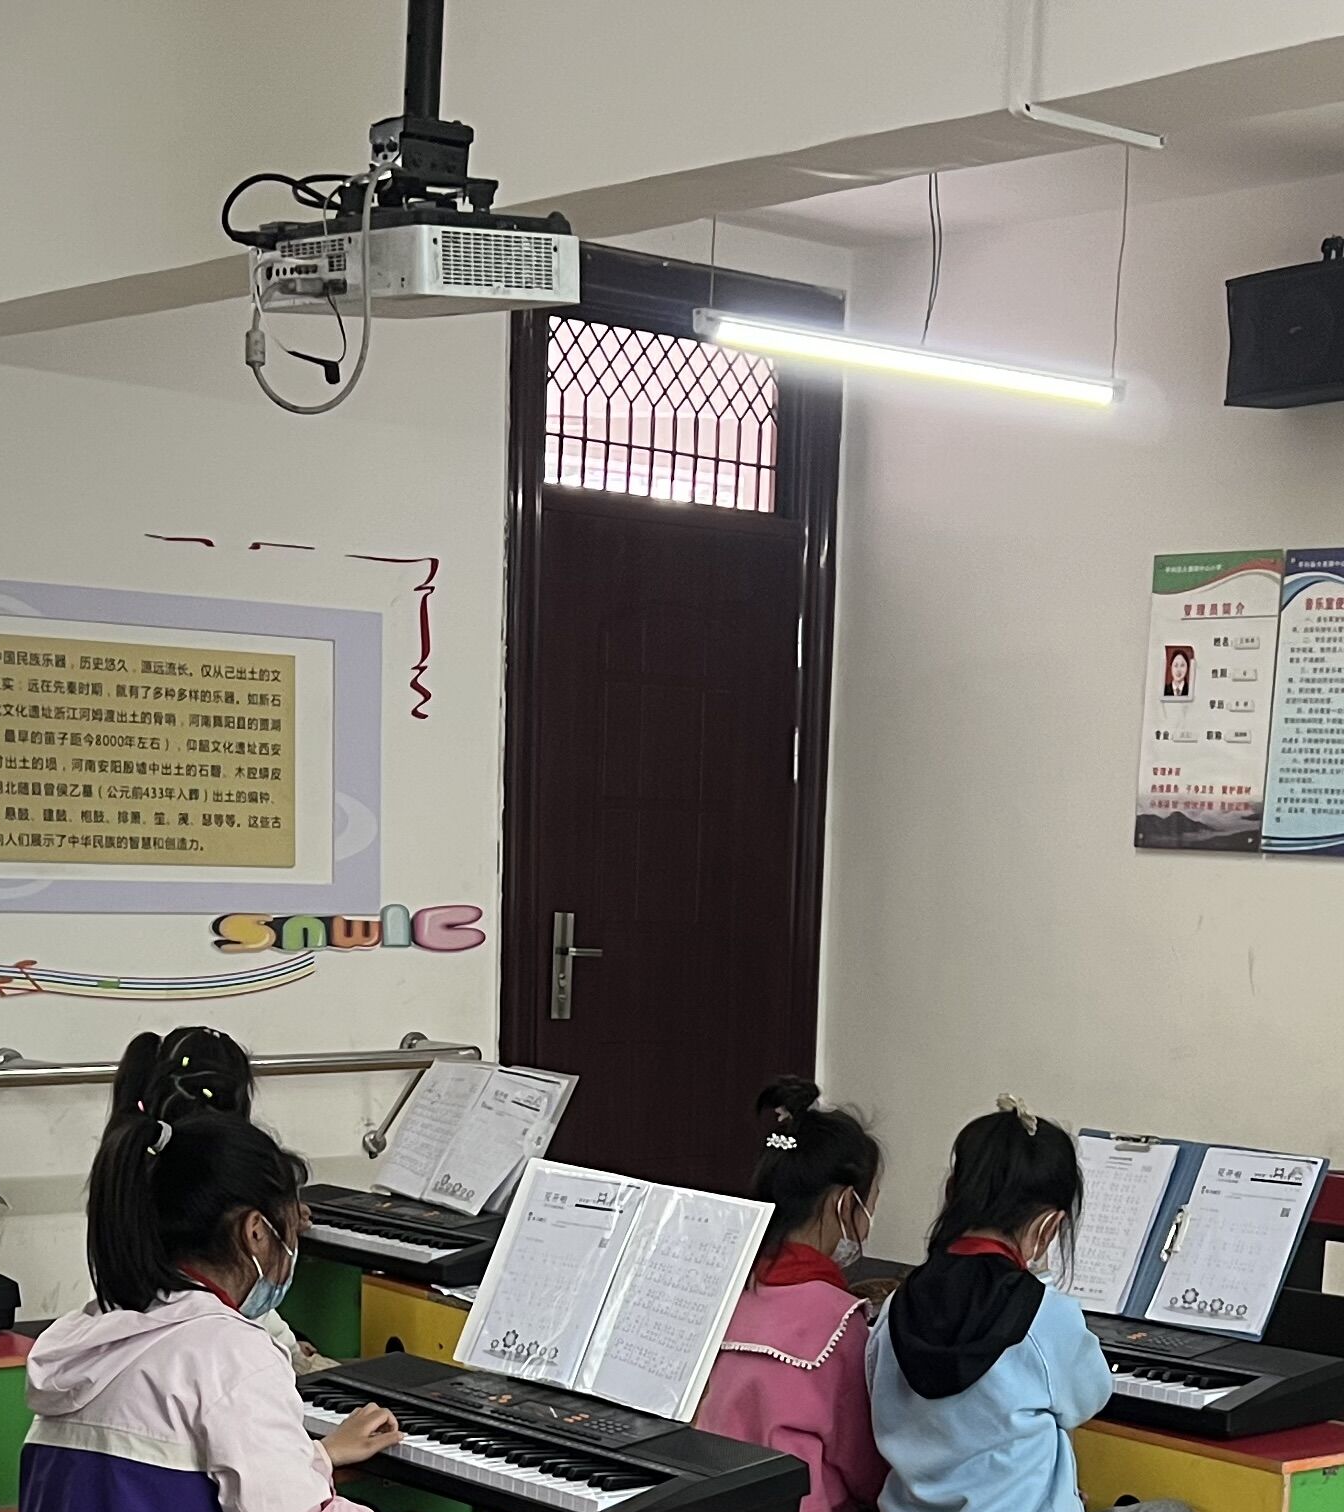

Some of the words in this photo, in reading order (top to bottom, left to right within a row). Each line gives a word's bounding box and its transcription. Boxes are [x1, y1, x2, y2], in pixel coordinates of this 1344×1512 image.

[1184, 602, 1245, 616] 管理员简介
